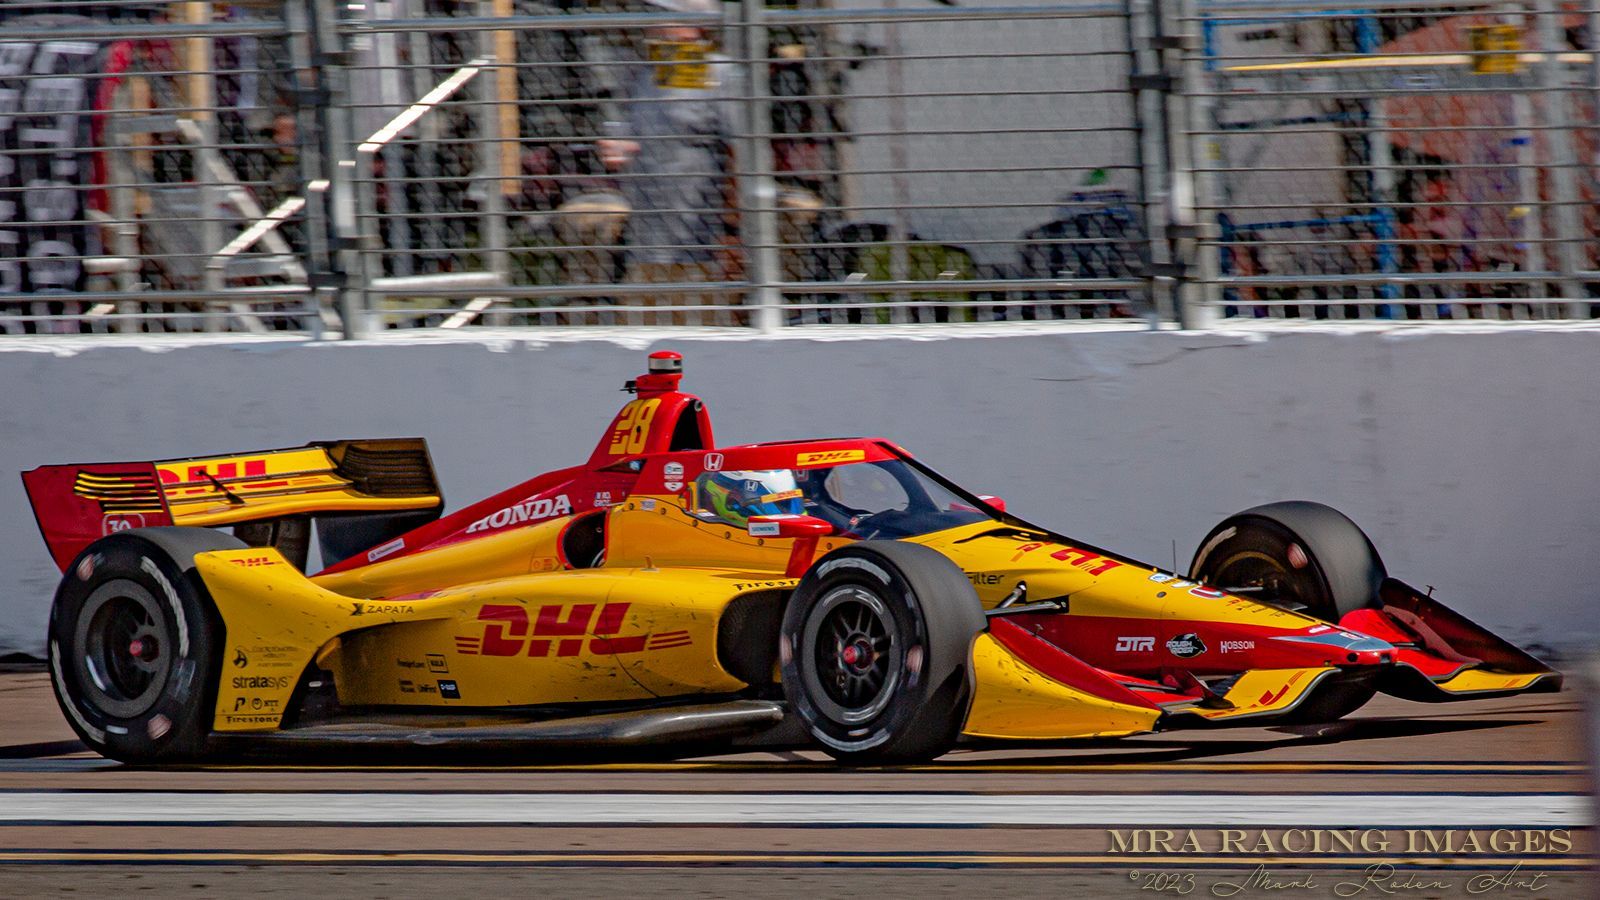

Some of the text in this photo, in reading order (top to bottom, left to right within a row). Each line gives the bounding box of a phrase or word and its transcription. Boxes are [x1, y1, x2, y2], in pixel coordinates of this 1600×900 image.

[608, 398, 661, 455] 28
[807, 451, 856, 463] DHL
[465, 494, 572, 534] HONDA
[229, 556, 277, 567] DHL
[732, 579, 801, 591] Firest
[367, 605, 415, 614] ZAPATA
[477, 602, 648, 658] DHL
[1115, 636, 1156, 652] DTR
[1165, 640, 1193, 648] ROUGH
[1220, 640, 1255, 653] HOBSON
[232, 675, 289, 691] stratasys
[226, 716, 280, 724] Firestone
